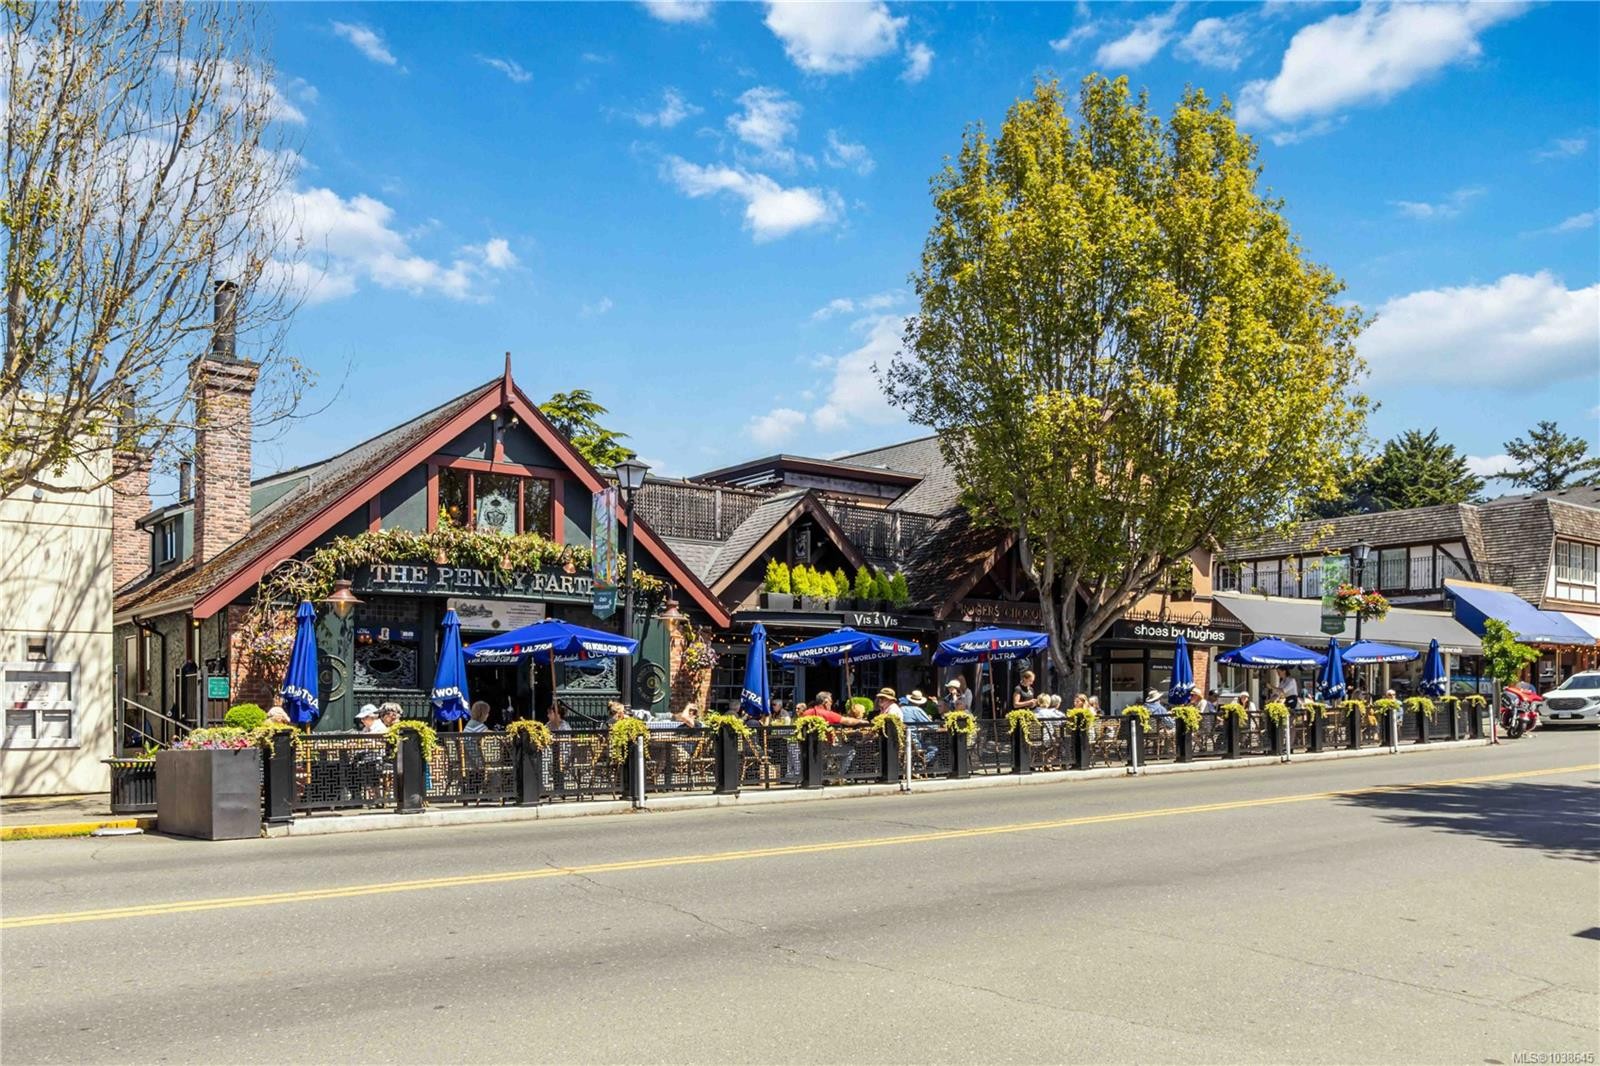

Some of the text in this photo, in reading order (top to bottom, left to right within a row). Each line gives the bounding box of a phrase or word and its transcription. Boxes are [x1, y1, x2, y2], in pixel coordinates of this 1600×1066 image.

[370, 564, 428, 584] THE
[1134, 624, 1169, 637] shoes
[1187, 628, 1225, 641] hughes
[521, 642, 553, 654] ULTRA
[999, 639, 1031, 648] ULTRA
[799, 646, 823, 656] WORLD
[824, 645, 839, 653] CUP
[853, 653, 877, 662] WORLD
[987, 652, 1017, 661] ULTRA
[741, 688, 762, 705] LTRA
